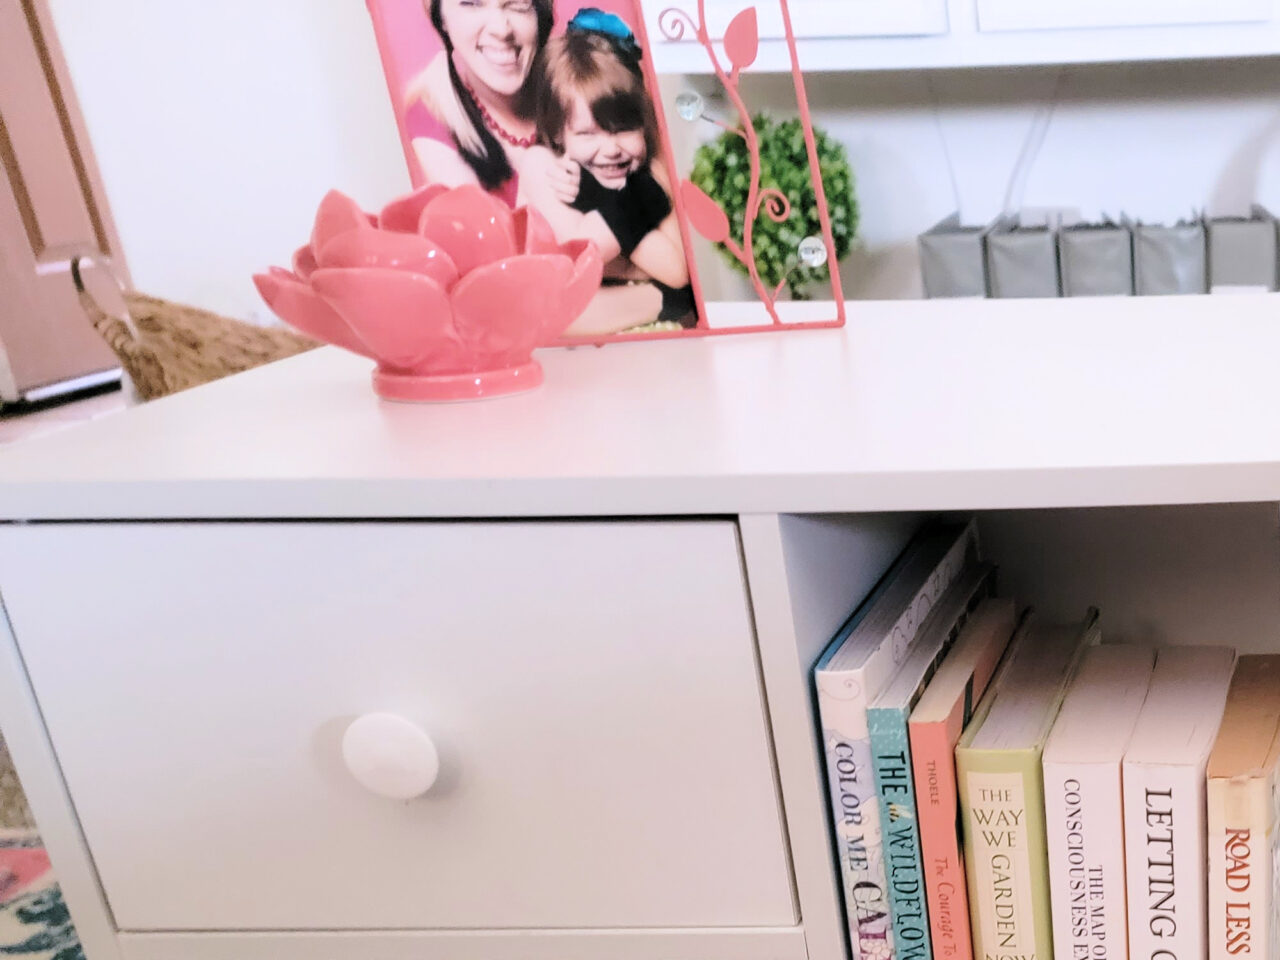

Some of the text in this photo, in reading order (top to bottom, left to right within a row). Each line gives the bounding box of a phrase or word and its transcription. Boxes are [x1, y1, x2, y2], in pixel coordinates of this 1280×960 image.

[835, 742, 863, 825] COLOR
[878, 751, 908, 796] THE
[927, 760, 940, 805] THOELE
[979, 789, 1012, 802] THE
[973, 808, 1023, 826] WAY
[982, 831, 1016, 847] WE
[846, 834, 868, 871] ME
[1063, 778, 1089, 937] CONSCIOUSNESS
[1145, 787, 1177, 938] LETTING
[1225, 828, 1251, 893] ROAD
[991, 854, 1017, 948] GARDEN
[1089, 864, 1104, 900] THE
[937, 882, 955, 938] Courage
[1090, 906, 1106, 940] MAP
[1225, 902, 1251, 955] LESS
[944, 945, 957, 956] To
